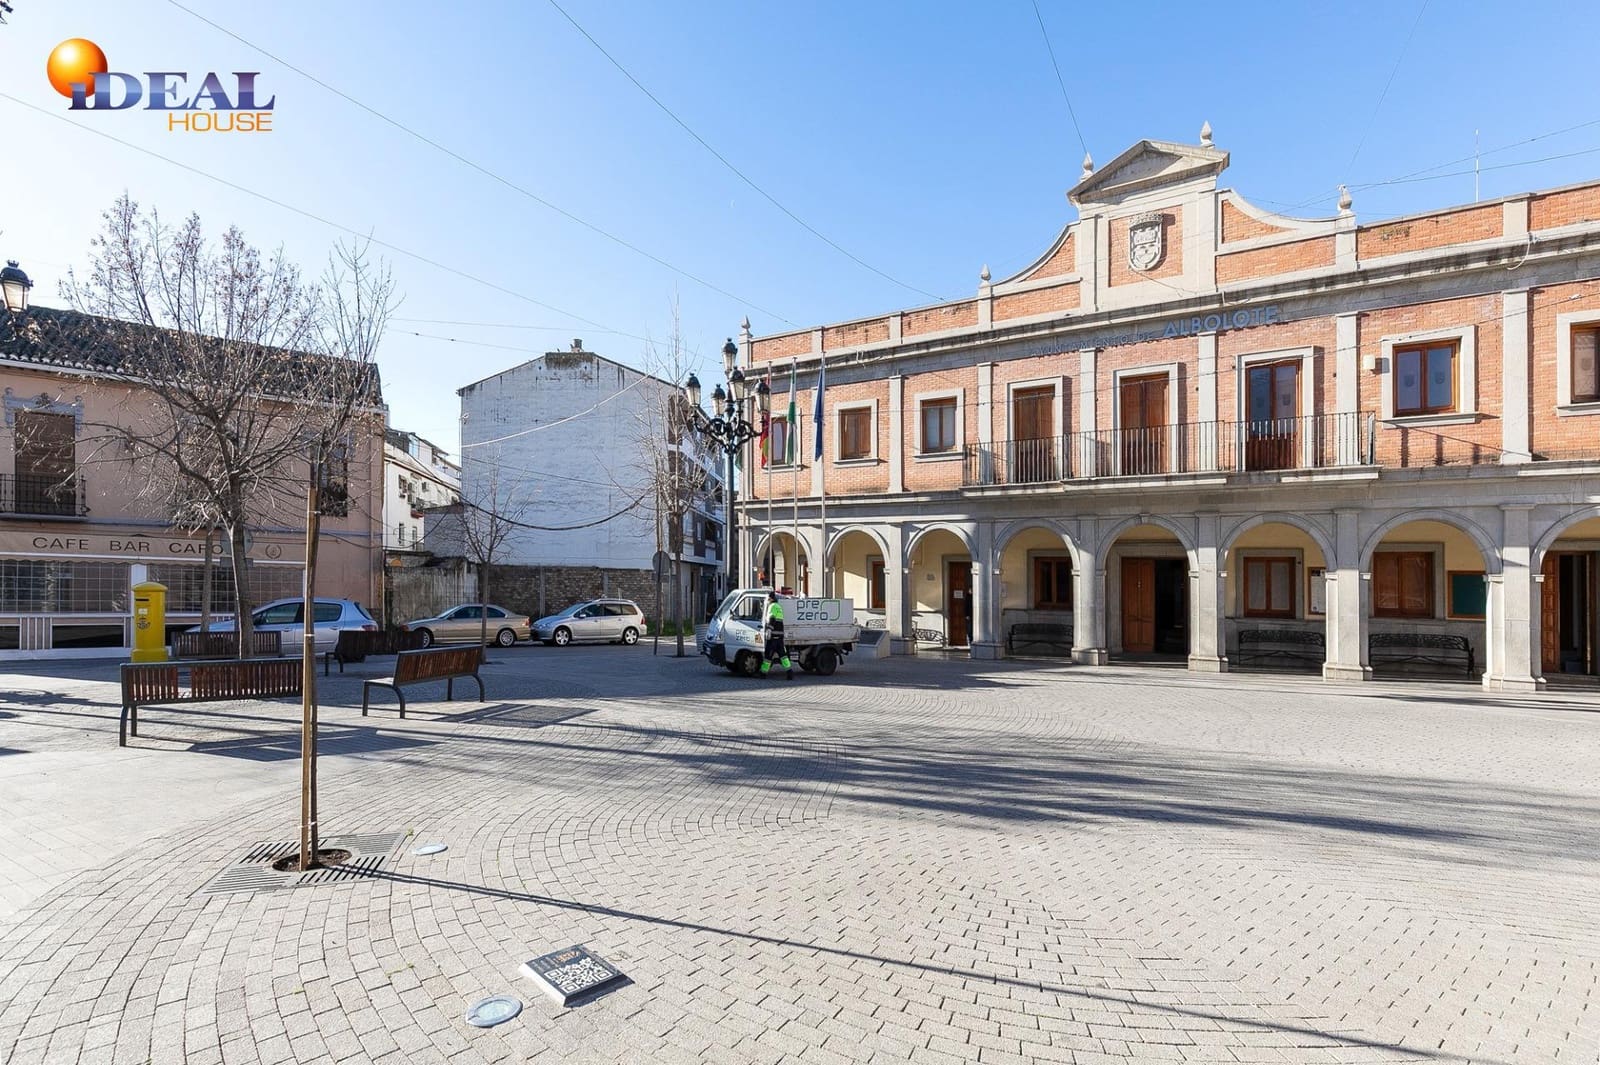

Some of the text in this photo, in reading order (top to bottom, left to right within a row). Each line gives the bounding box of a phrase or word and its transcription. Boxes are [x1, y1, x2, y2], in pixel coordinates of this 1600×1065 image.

[1163, 304, 1279, 338] ALBOLOTE
[32, 536, 89, 551] CAFE
[109, 540, 150, 552] BAR
[796, 600, 820, 611] pre
[796, 611, 829, 621] zero
